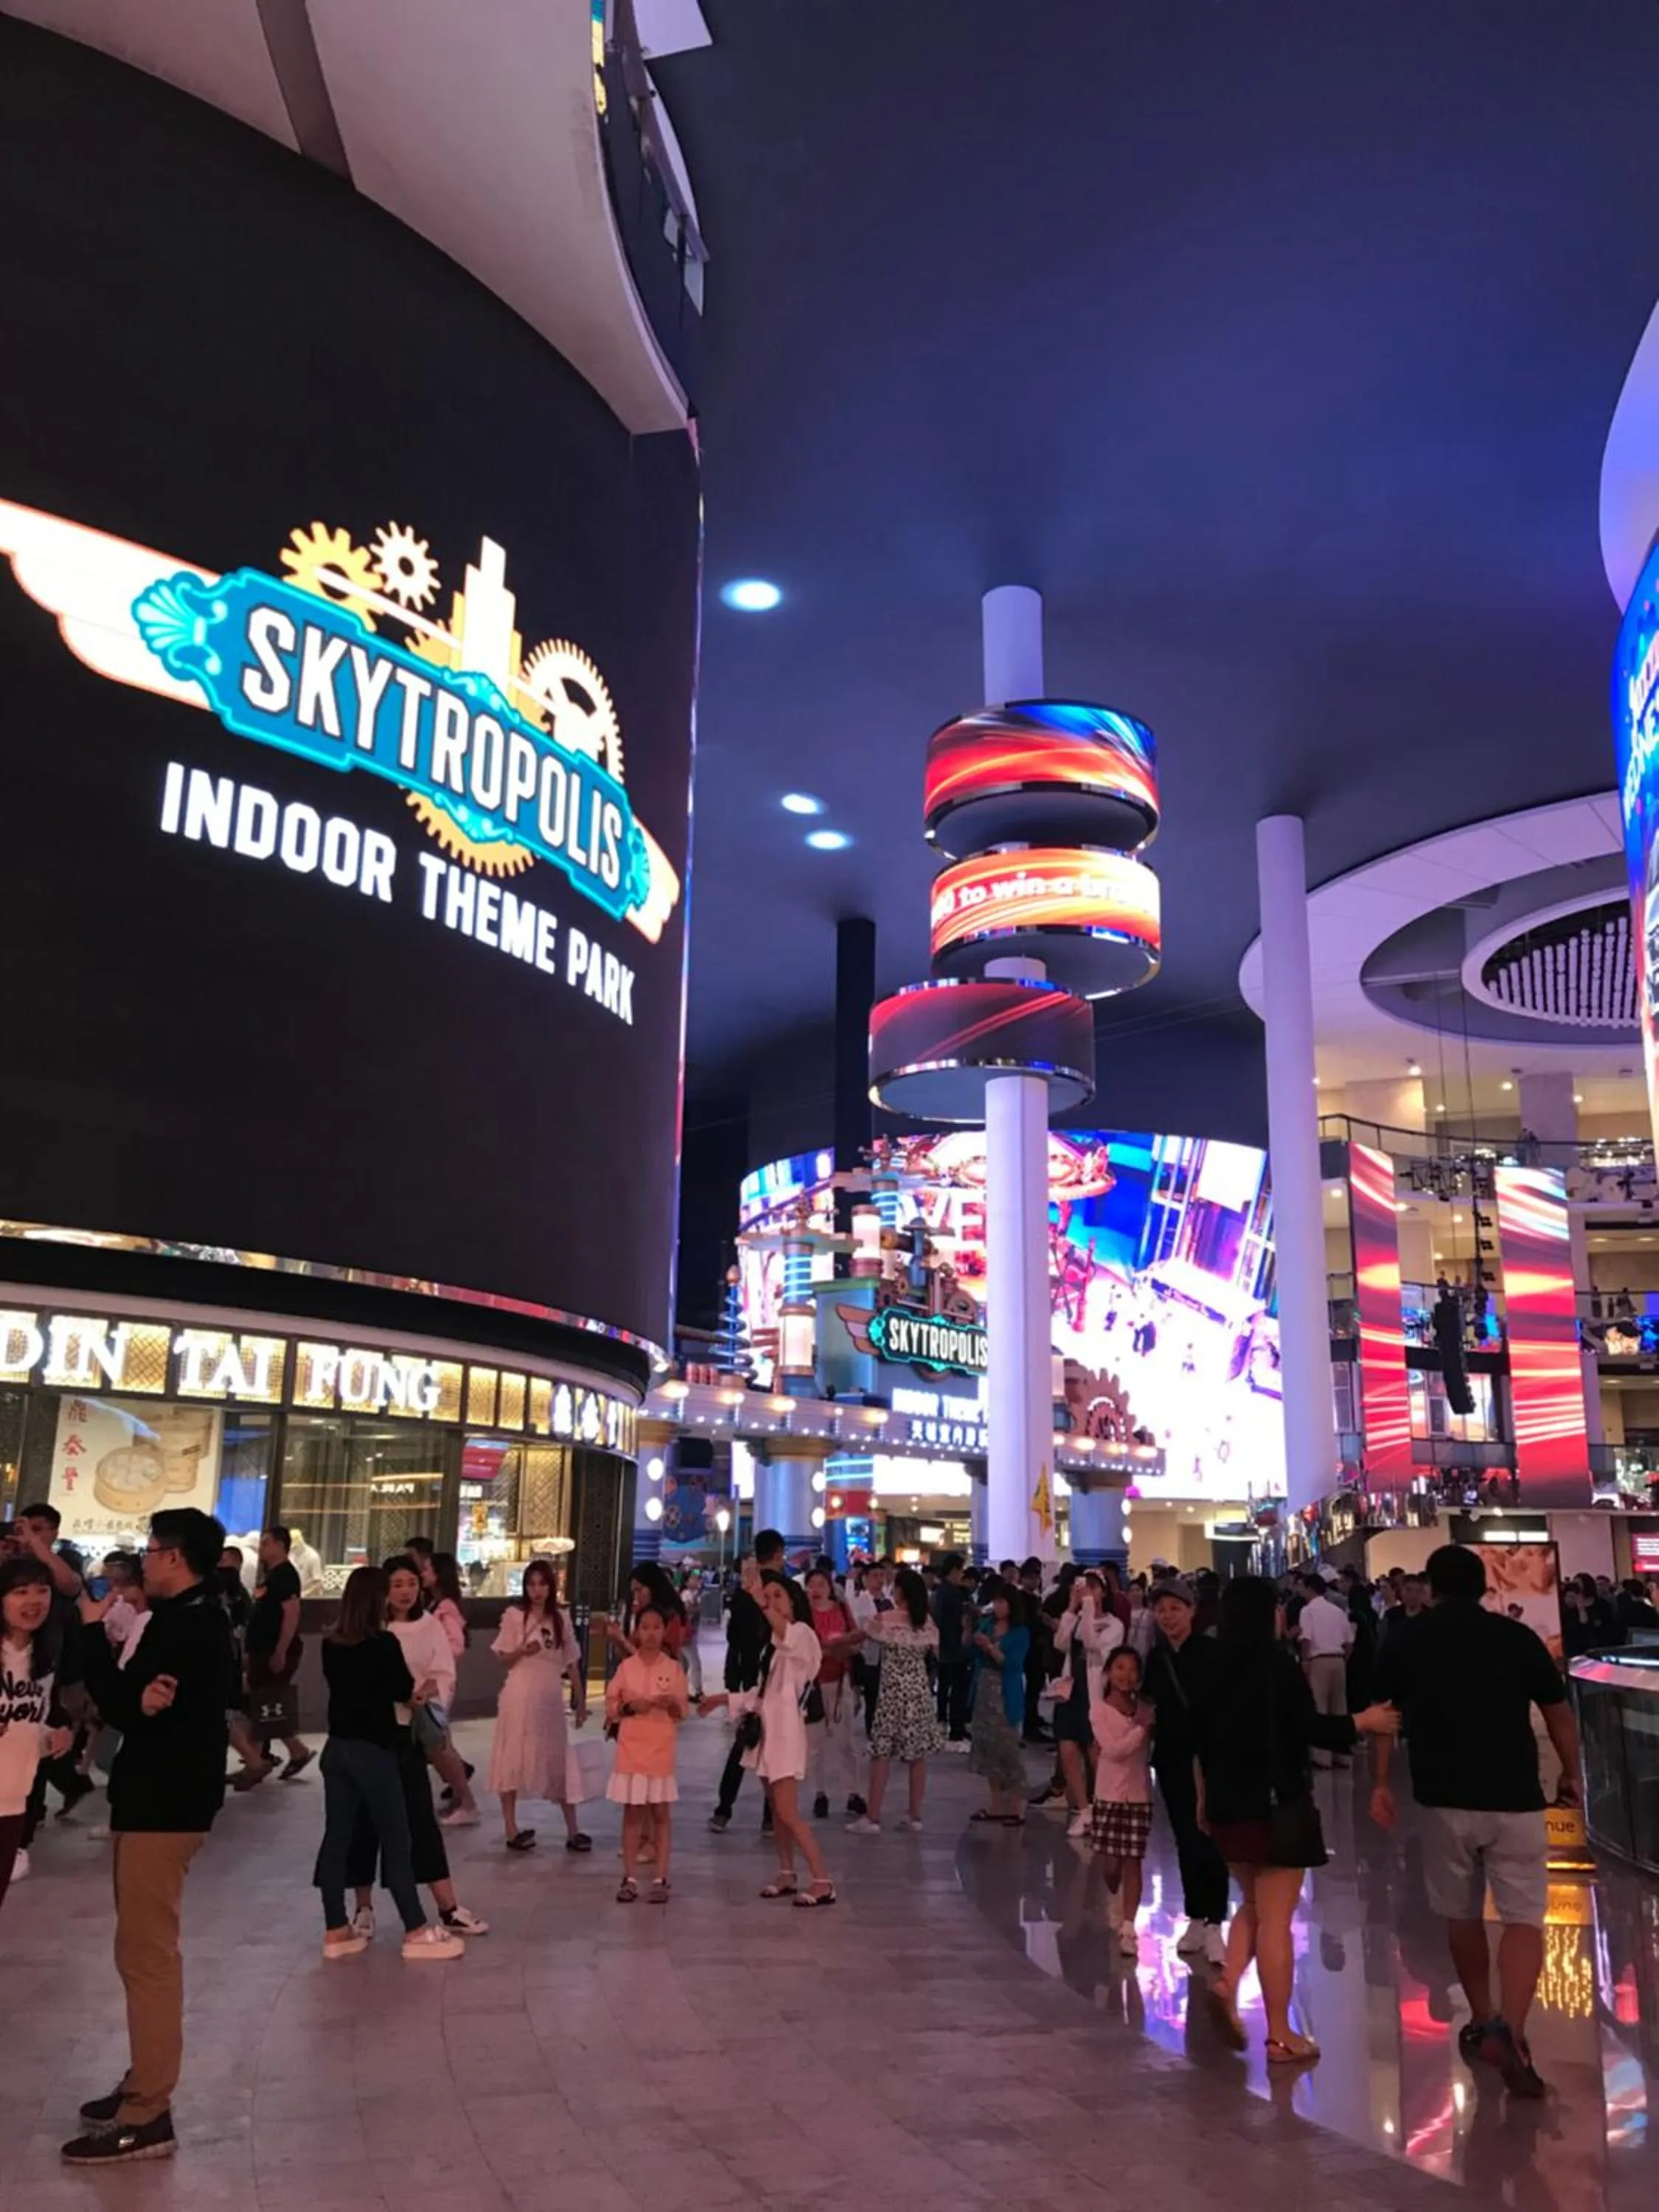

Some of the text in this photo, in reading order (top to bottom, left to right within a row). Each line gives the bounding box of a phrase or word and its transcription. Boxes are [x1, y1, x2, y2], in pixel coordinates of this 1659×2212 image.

[241, 605, 623, 890] SKYTROPOLIS
[160, 760, 636, 1026] INDOOR THEME PARK
[959, 883, 987, 906] to
[990, 872, 1046, 897] win
[0, 1318, 441, 1412] DIN TAI FUNG
[888, 1317, 988, 1368] SKYTROPOLIS
